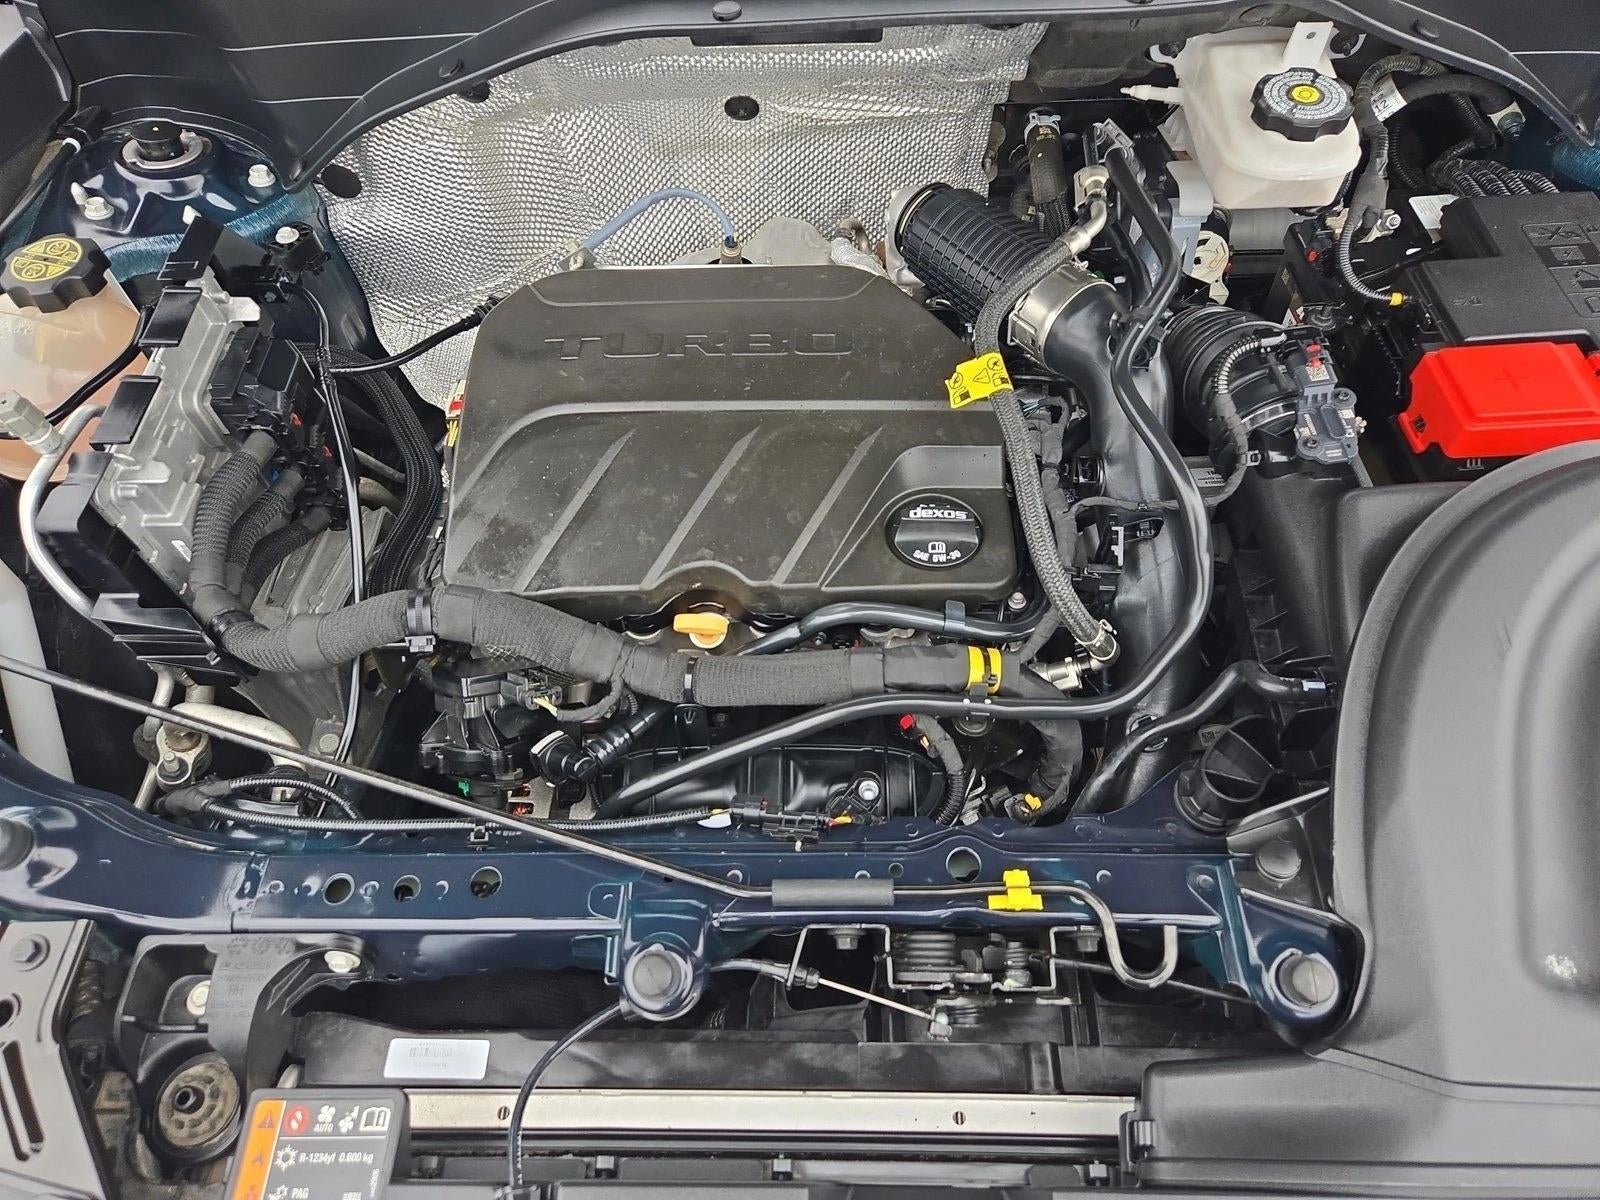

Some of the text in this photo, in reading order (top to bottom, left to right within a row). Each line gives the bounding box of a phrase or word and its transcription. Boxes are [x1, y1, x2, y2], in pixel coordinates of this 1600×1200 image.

[544, 334, 852, 359] TURBO
[909, 507, 967, 519] dexos
[913, 550, 961, 562] SAE 5W-30
[314, 1123, 334, 1132] AUTO
[299, 1152, 337, 1164] R-1234yf
[362, 1152, 374, 1164] kg
[291, 1187, 309, 1199] PAG
